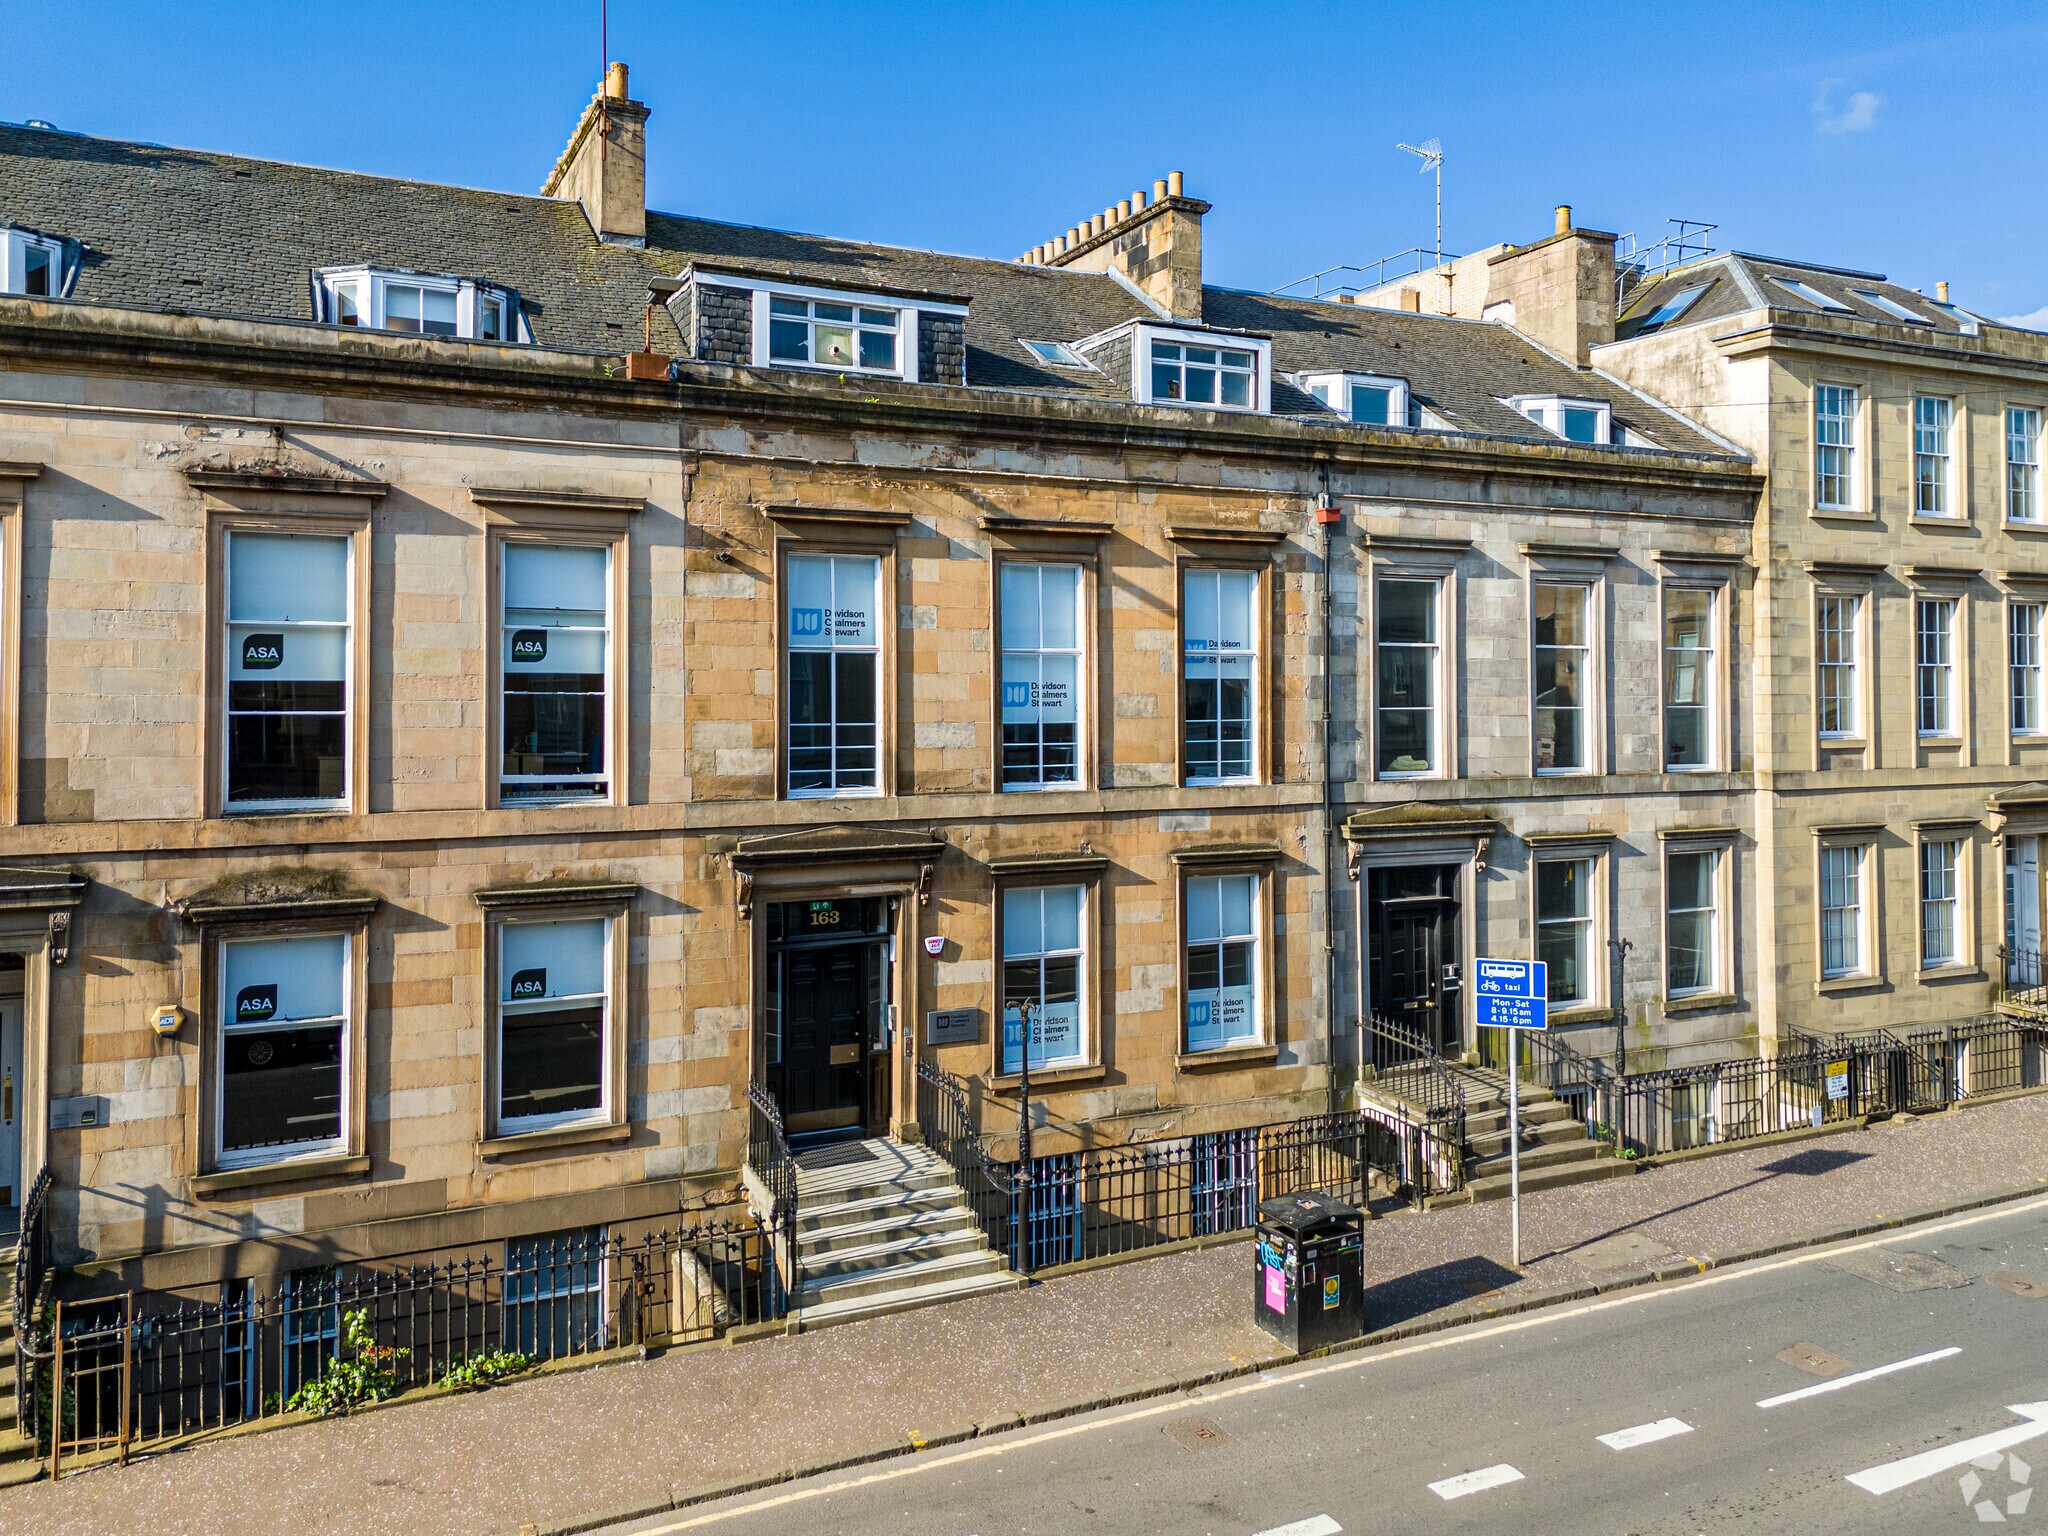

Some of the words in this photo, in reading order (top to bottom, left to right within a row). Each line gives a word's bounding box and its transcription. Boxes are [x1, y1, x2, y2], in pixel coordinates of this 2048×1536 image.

[824, 609, 865, 618] Dvidson
[824, 618, 866, 627] Calmers
[824, 627, 860, 636] Sewart
[515, 641, 543, 652] ASA
[246, 646, 279, 658] ASA
[1208, 656, 1237, 664] Stwart
[1031, 699, 1063, 707] Stwart
[810, 910, 840, 925] 163
[513, 981, 543, 993] ASA
[1504, 983, 1521, 991] taxi
[240, 998, 273, 1011] ASA
[159, 1016, 175, 1025] ADT
[1211, 1015, 1240, 1024] Stwart
[1033, 1034, 1064, 1044] Stwart
